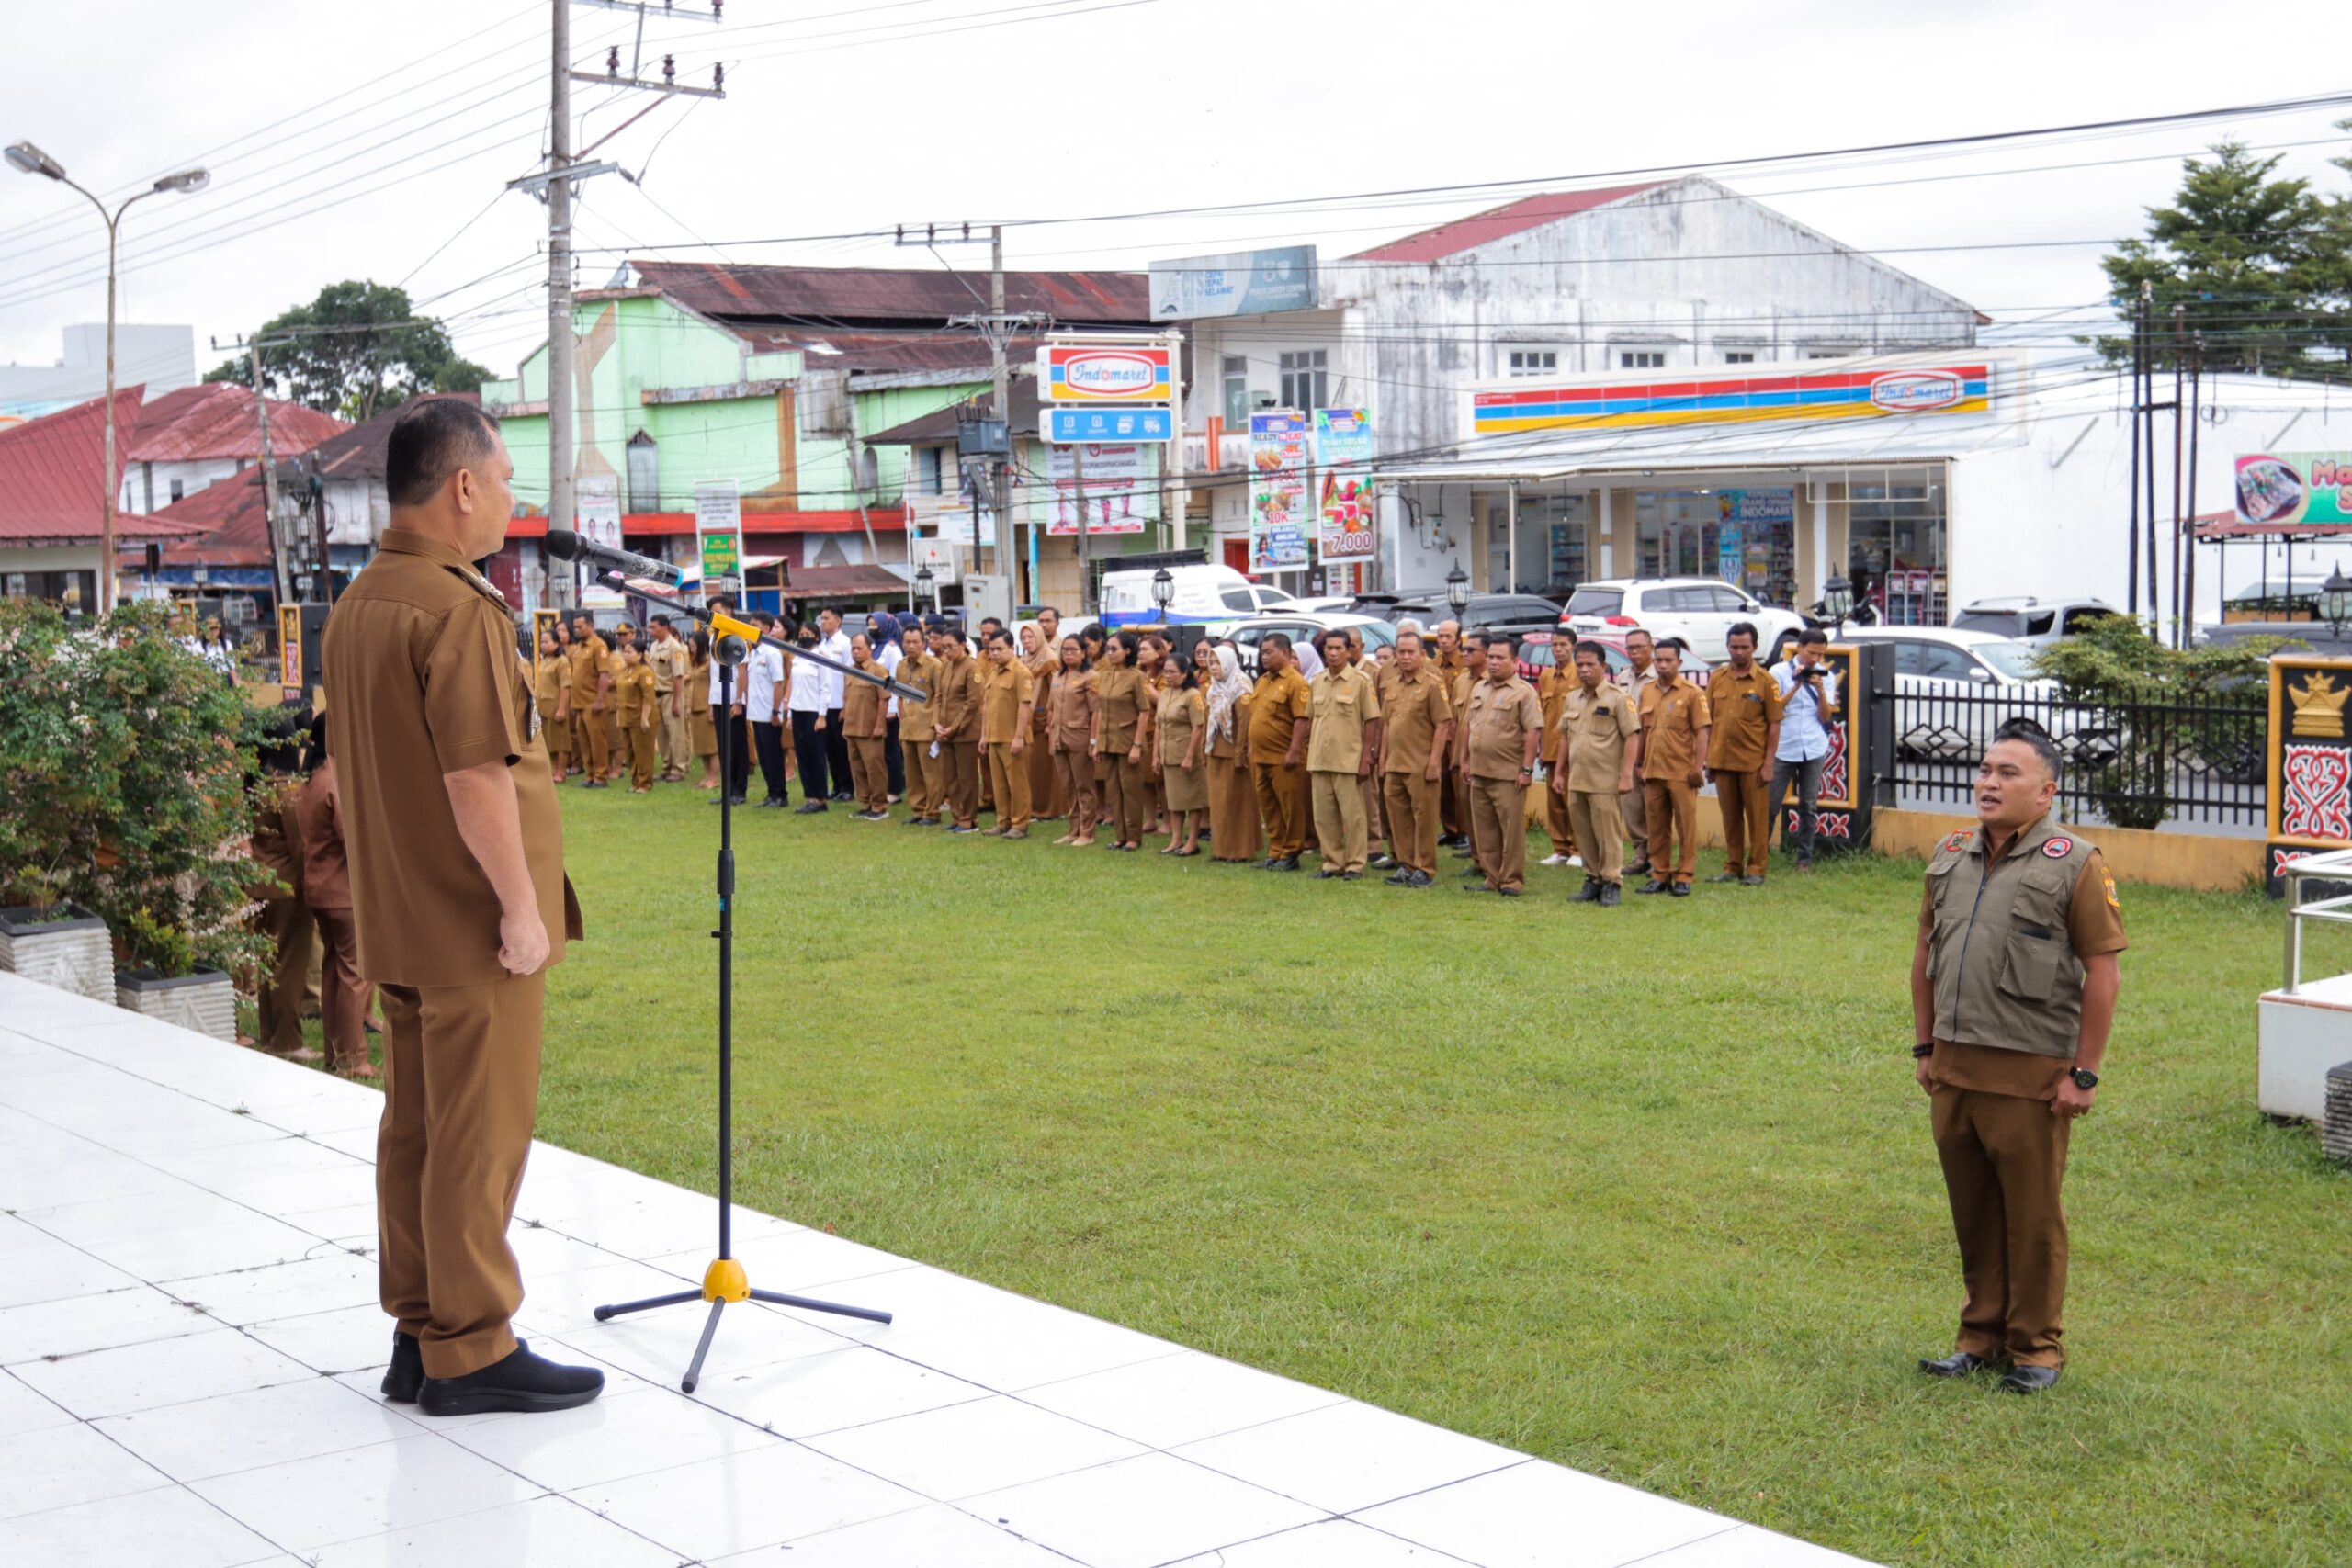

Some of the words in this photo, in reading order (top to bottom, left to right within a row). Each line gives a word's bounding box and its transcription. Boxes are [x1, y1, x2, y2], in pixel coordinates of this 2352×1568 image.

[1204, 287, 1234, 296] SELAMAT
[1072, 364, 1148, 381] Indomaret
[1269, 513, 1288, 524] 10K
[1332, 533, 1372, 551] 7.000
